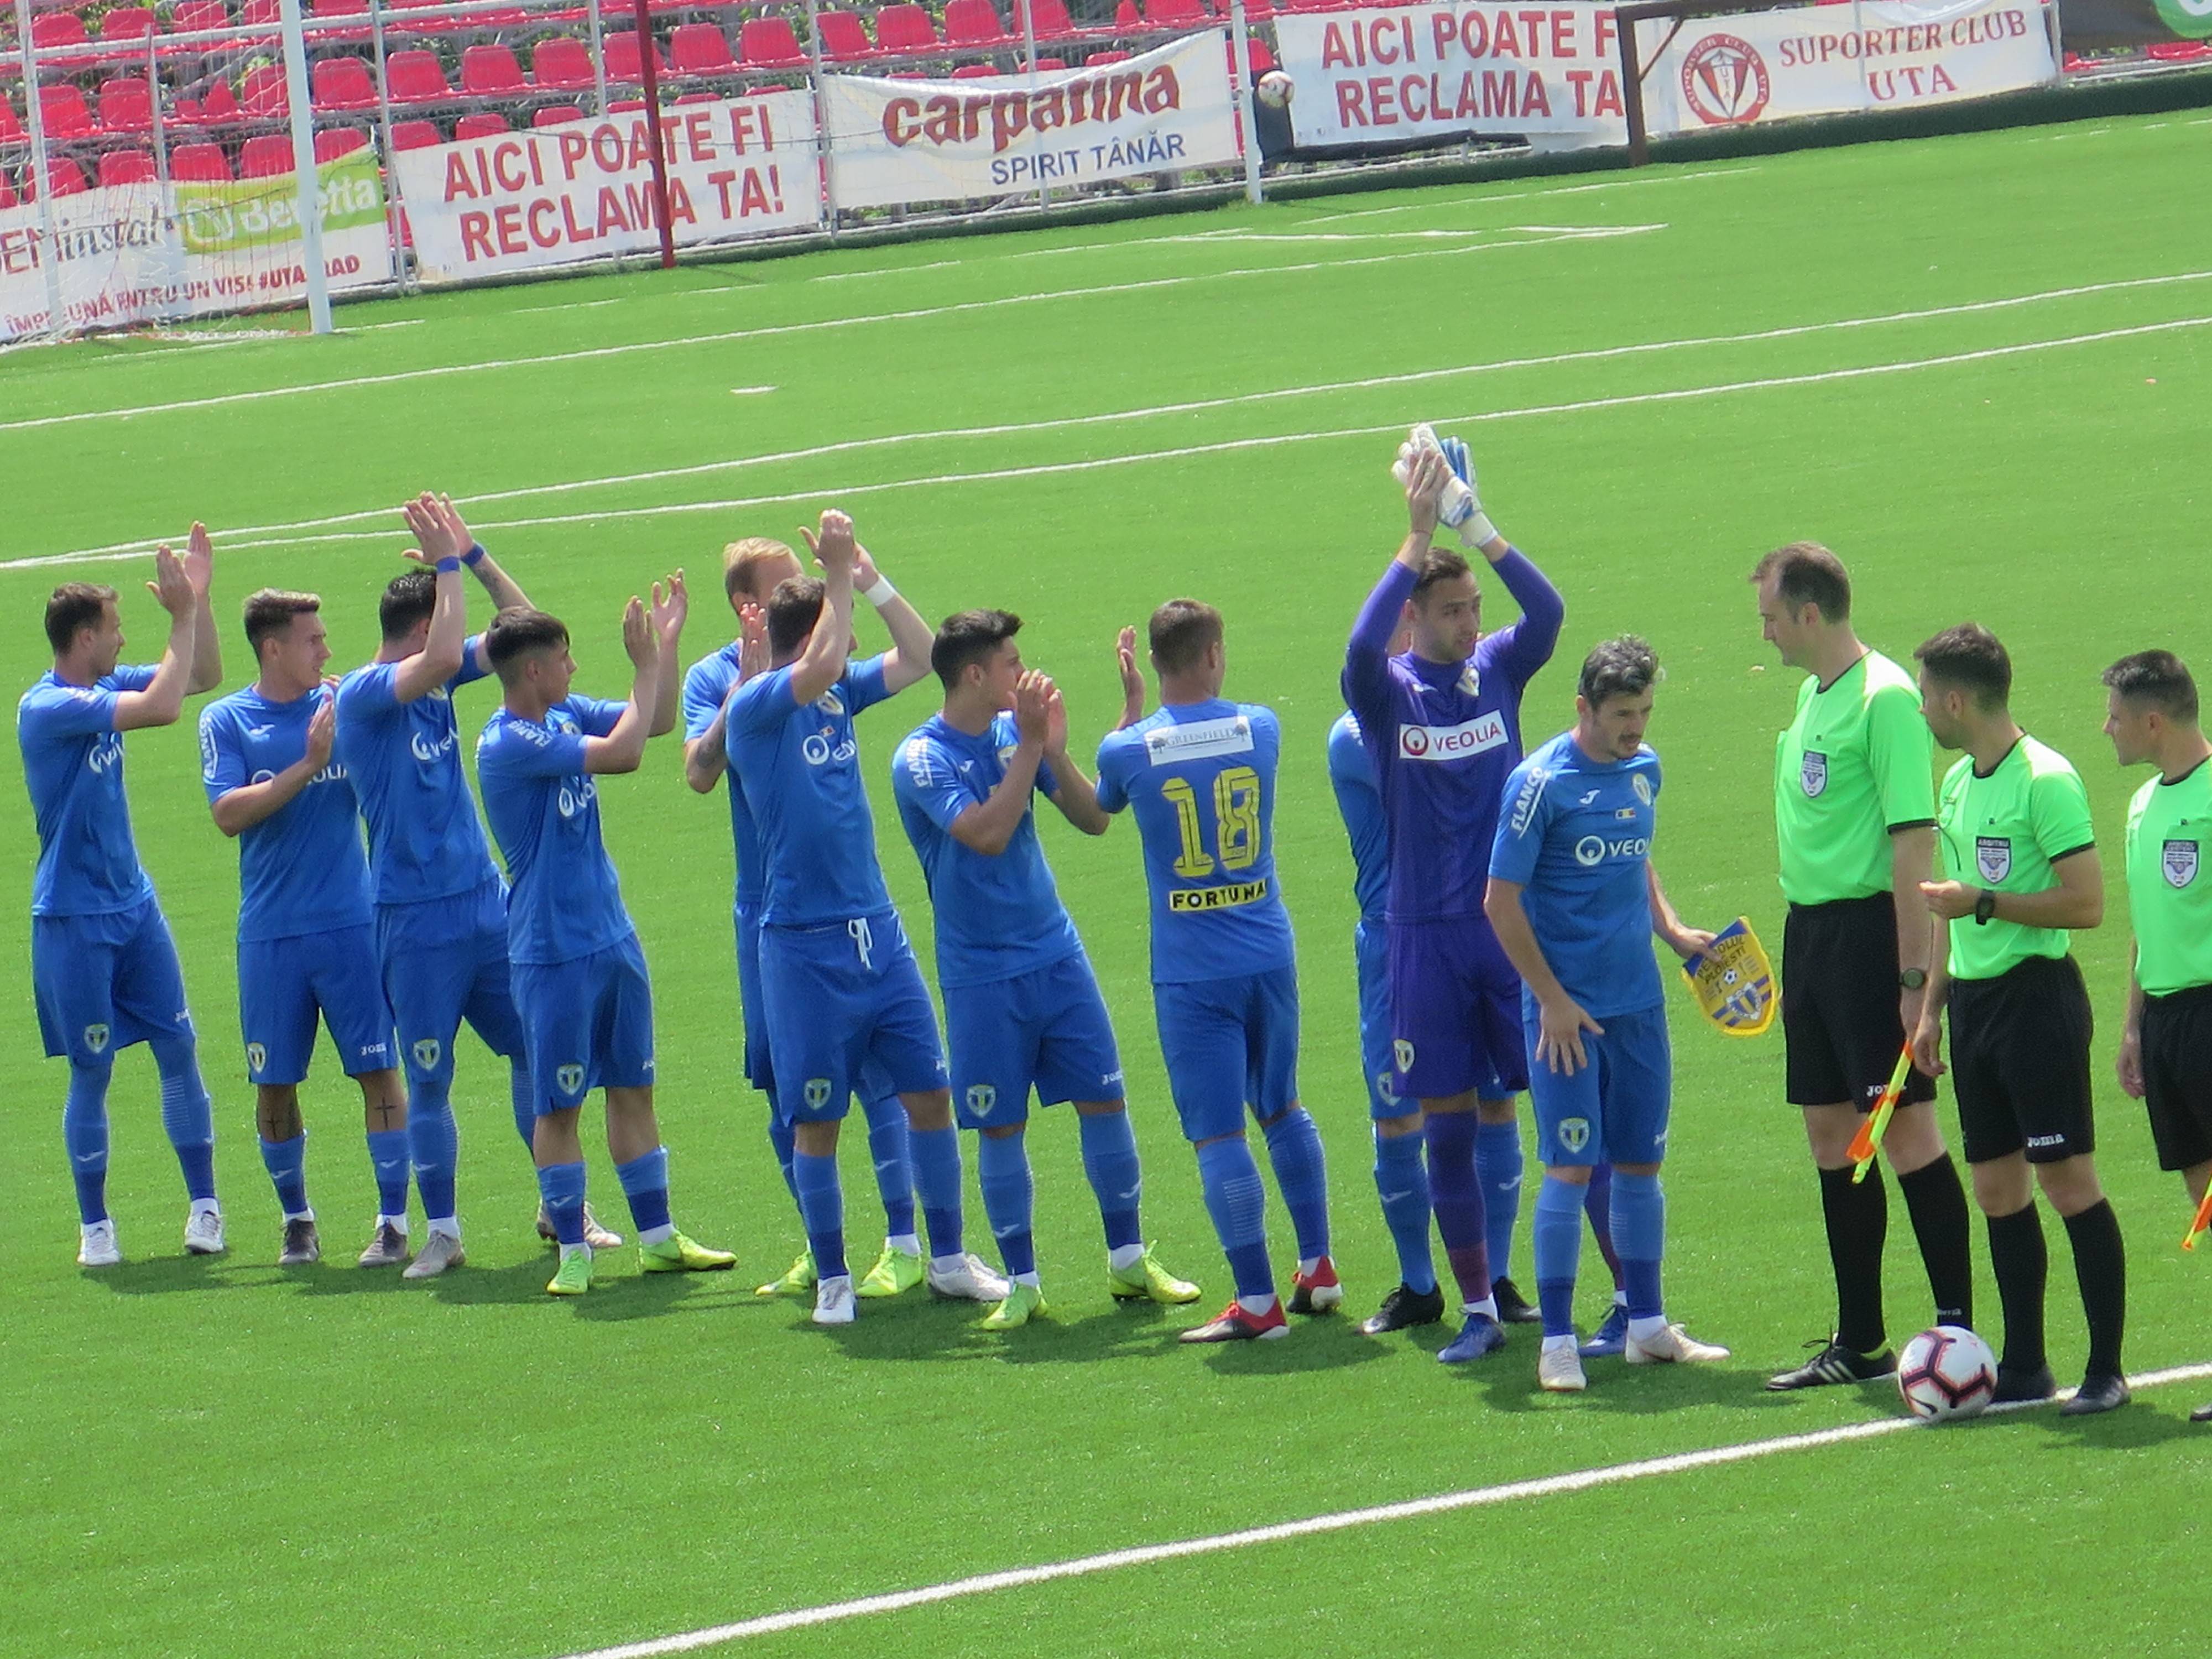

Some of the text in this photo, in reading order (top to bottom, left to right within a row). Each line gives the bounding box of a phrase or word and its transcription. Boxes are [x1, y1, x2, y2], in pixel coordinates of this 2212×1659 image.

[1322, 10, 1617, 69] AICI POATE F
[1778, 9, 2026, 67] SUPORTER CLUB
[1335, 70, 1552, 128] RECLAMA
[1867, 64, 1959, 101] UTA
[444, 105, 773, 202] AICI POATE FI
[992, 133, 1186, 185] SPIRIT TÂNĂR
[460, 165, 784, 262] RECLAMA TA!
[1433, 721, 1501, 752] VEOLIA
[1162, 766, 1261, 878] 18
[1510, 766, 1543, 831] FLANCO
[1609, 838, 1650, 857] VEO
[1172, 881, 1265, 908] FORTUNA
